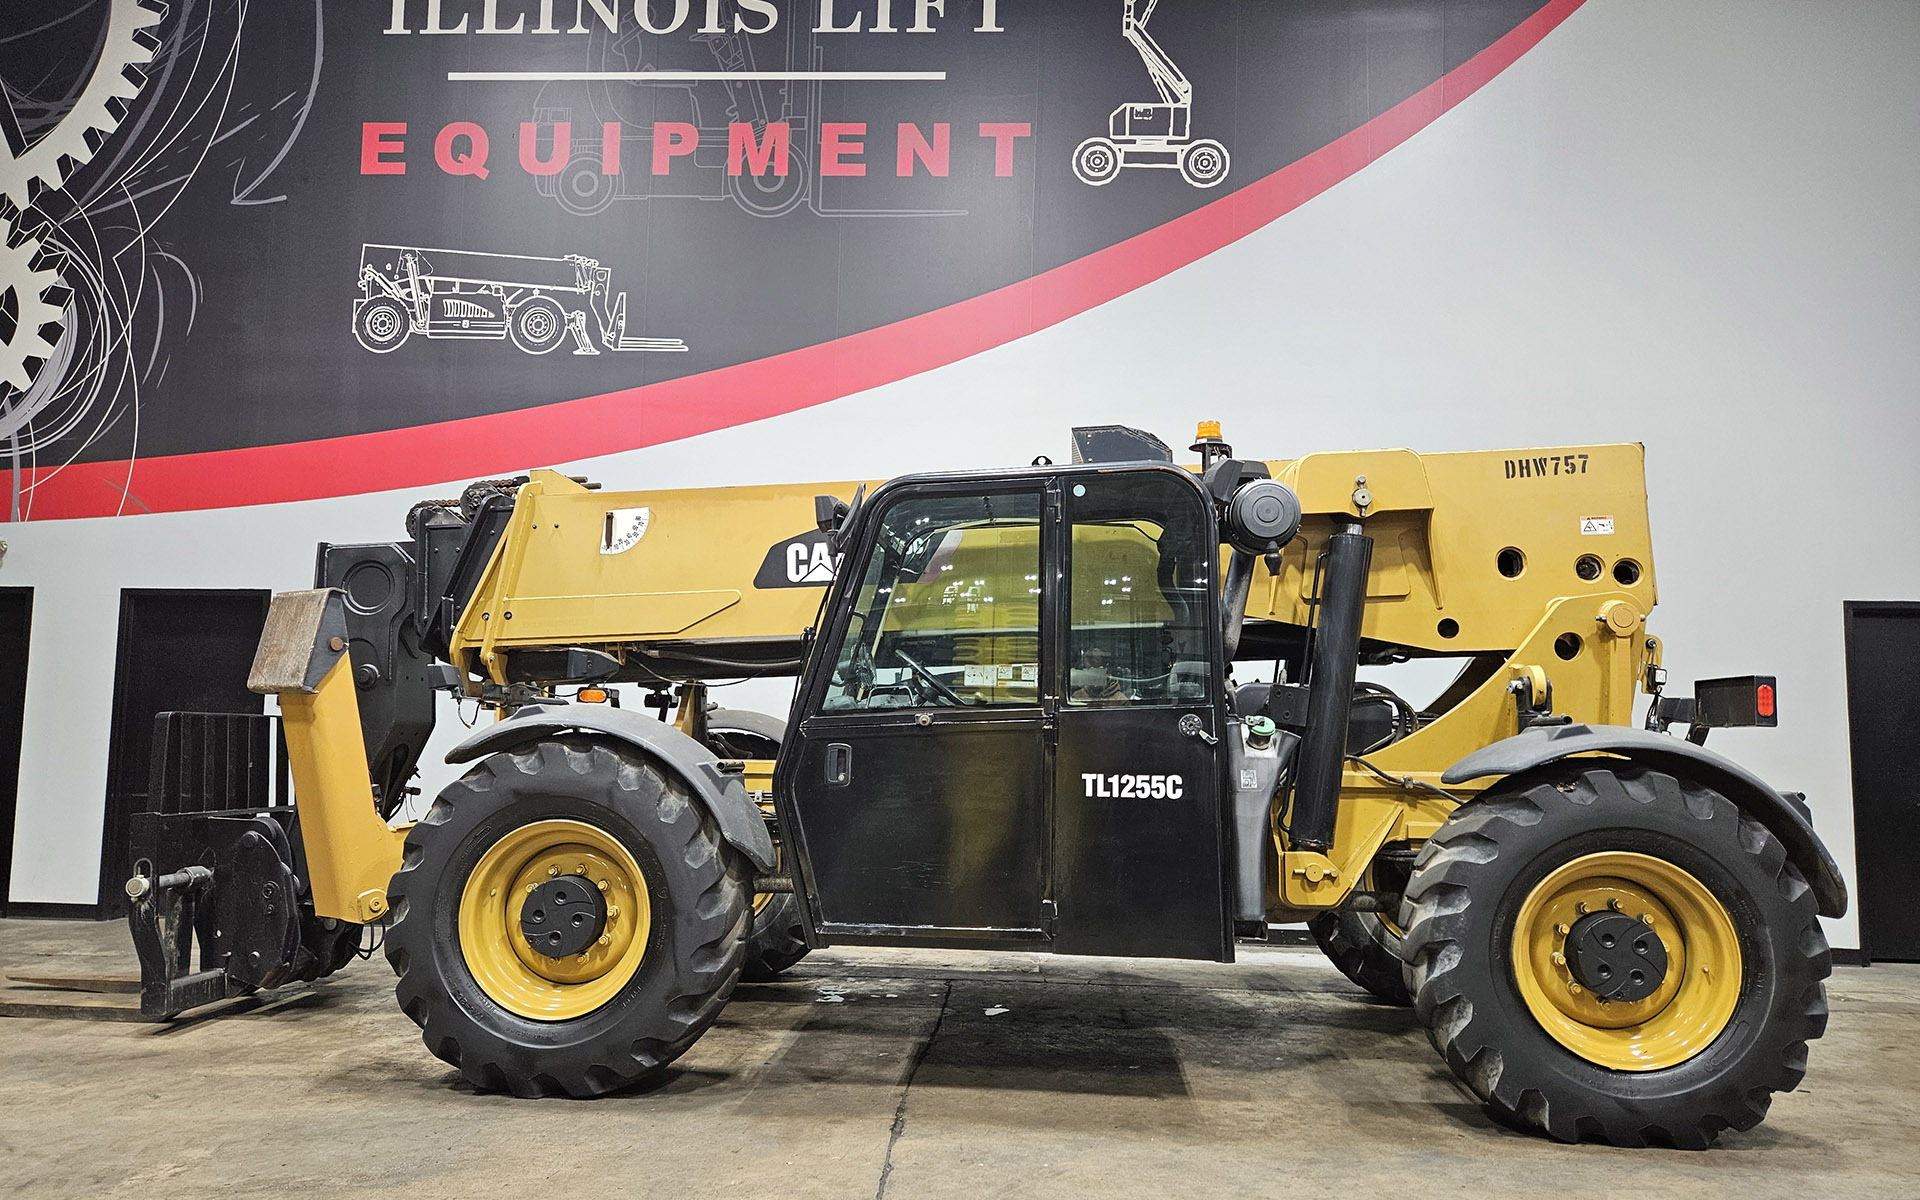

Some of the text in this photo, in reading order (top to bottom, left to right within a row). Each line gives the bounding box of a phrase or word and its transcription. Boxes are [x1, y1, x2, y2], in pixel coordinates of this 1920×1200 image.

[383, 0, 779, 34] ILLINOIS
[360, 121, 1031, 180] EQUIPMENT
[1504, 454, 1589, 479] DHW757
[1081, 773, 1183, 800] TL1255C
